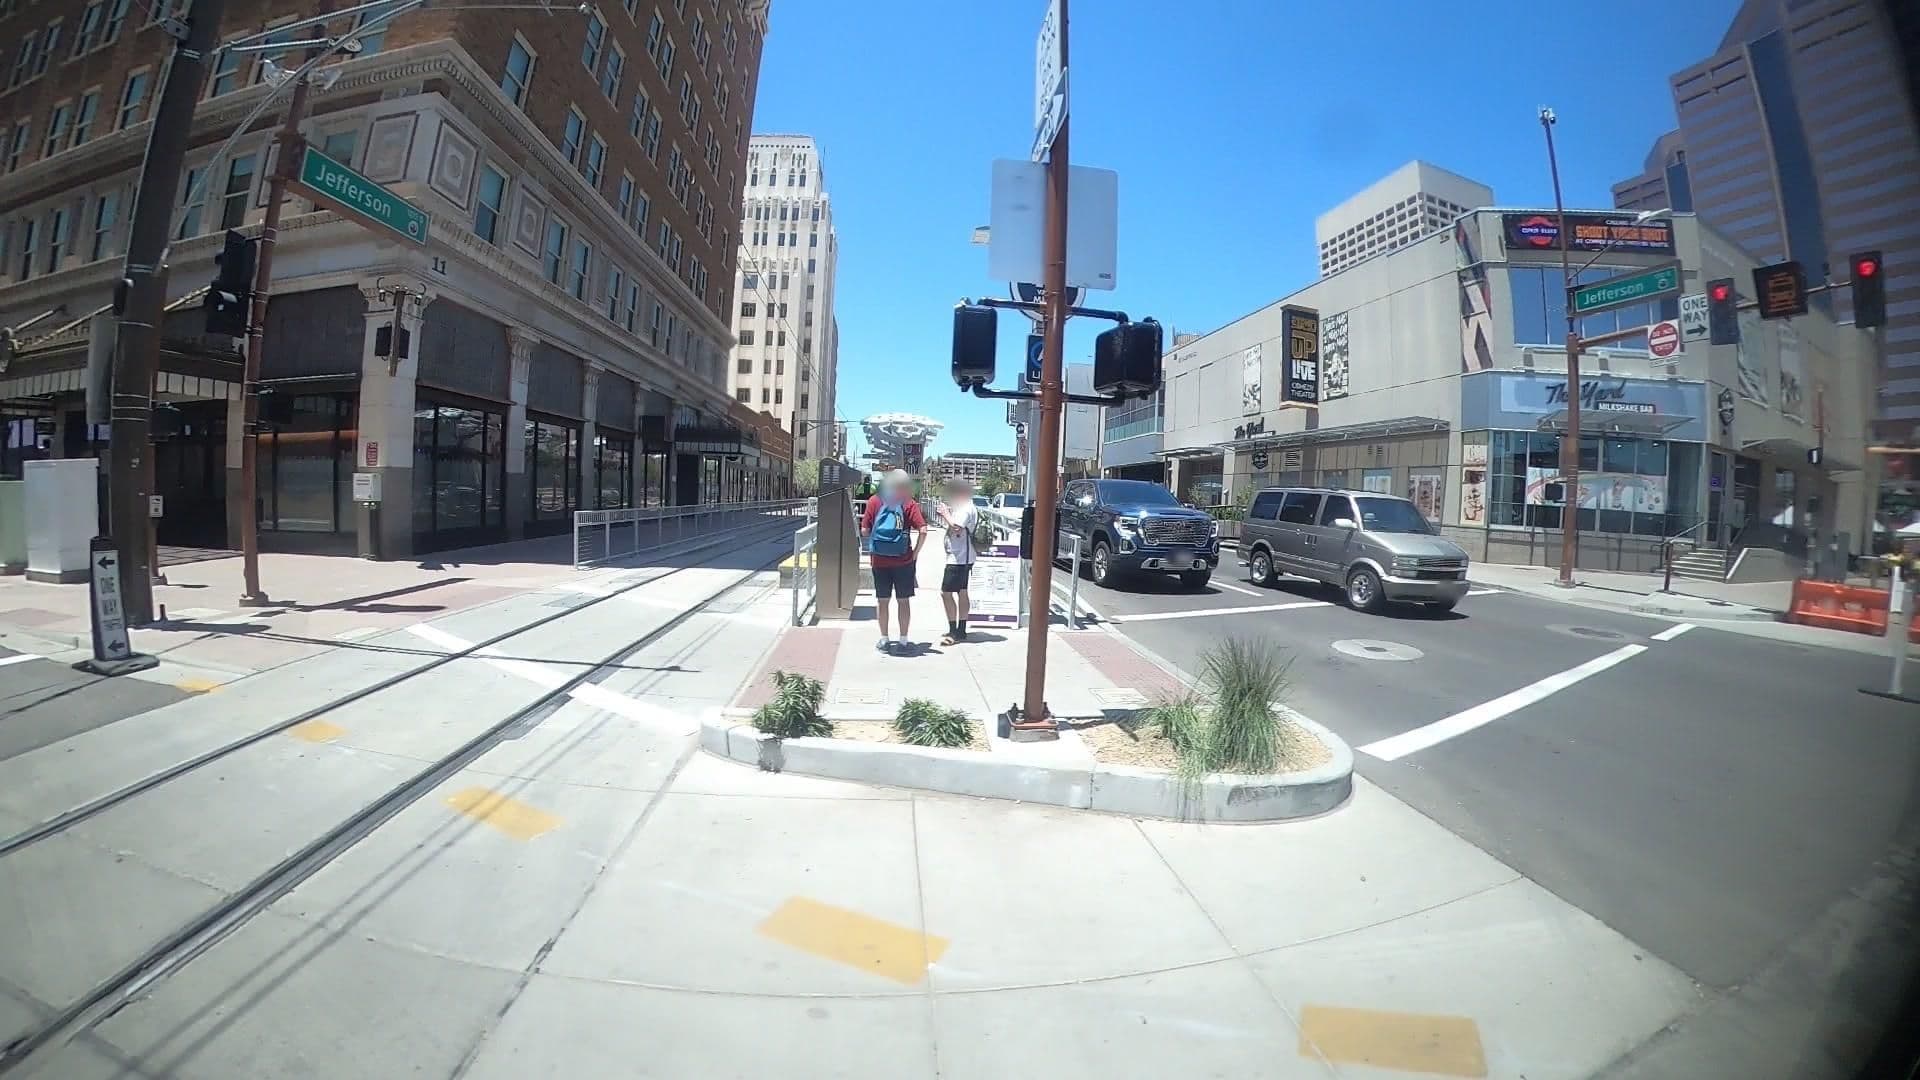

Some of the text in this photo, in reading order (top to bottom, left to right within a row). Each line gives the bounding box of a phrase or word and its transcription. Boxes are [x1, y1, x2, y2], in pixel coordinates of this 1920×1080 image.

[315, 164, 392, 218] Jefferson
[1583, 282, 1644, 305] Jefferson
[1683, 297, 1708, 311] ONE
[1683, 311, 1708, 324] WAY
[1292, 331, 1317, 359] UP
[1292, 360, 1316, 381] LIVE
[1599, 402, 1639, 412] MILKSHAKE
